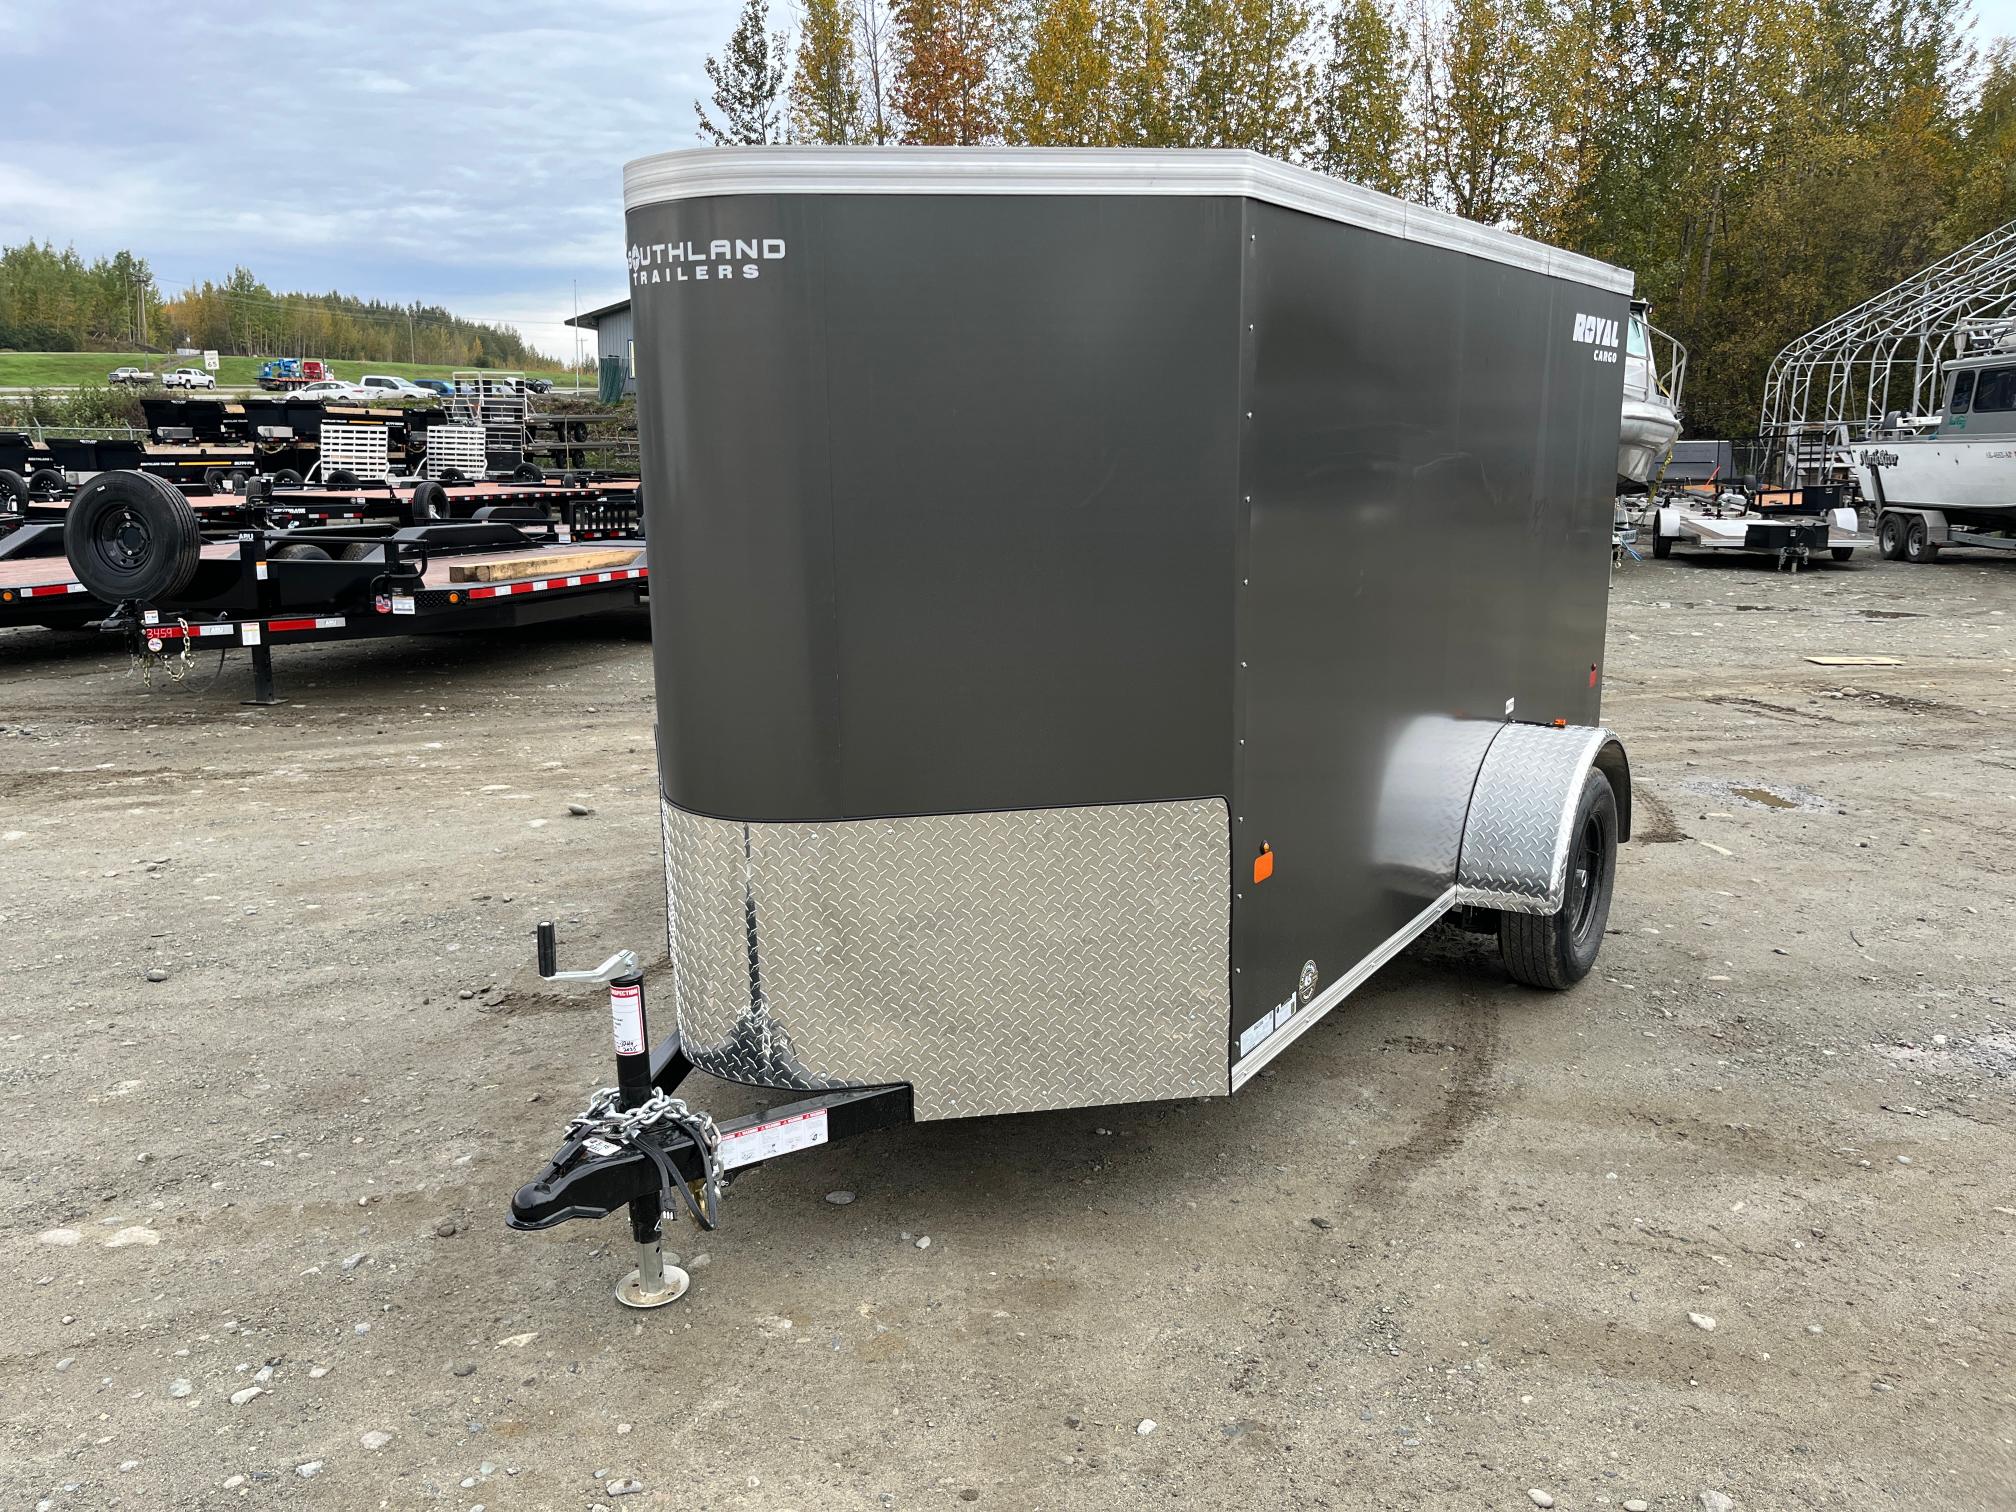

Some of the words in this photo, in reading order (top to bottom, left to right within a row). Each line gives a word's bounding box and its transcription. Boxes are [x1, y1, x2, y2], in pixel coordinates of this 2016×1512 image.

[633, 264, 759, 286] TRAILERS
[1573, 313, 1619, 348] ROYAL
[1593, 349, 1617, 363] CARGO
[146, 628, 173, 639] 3459
